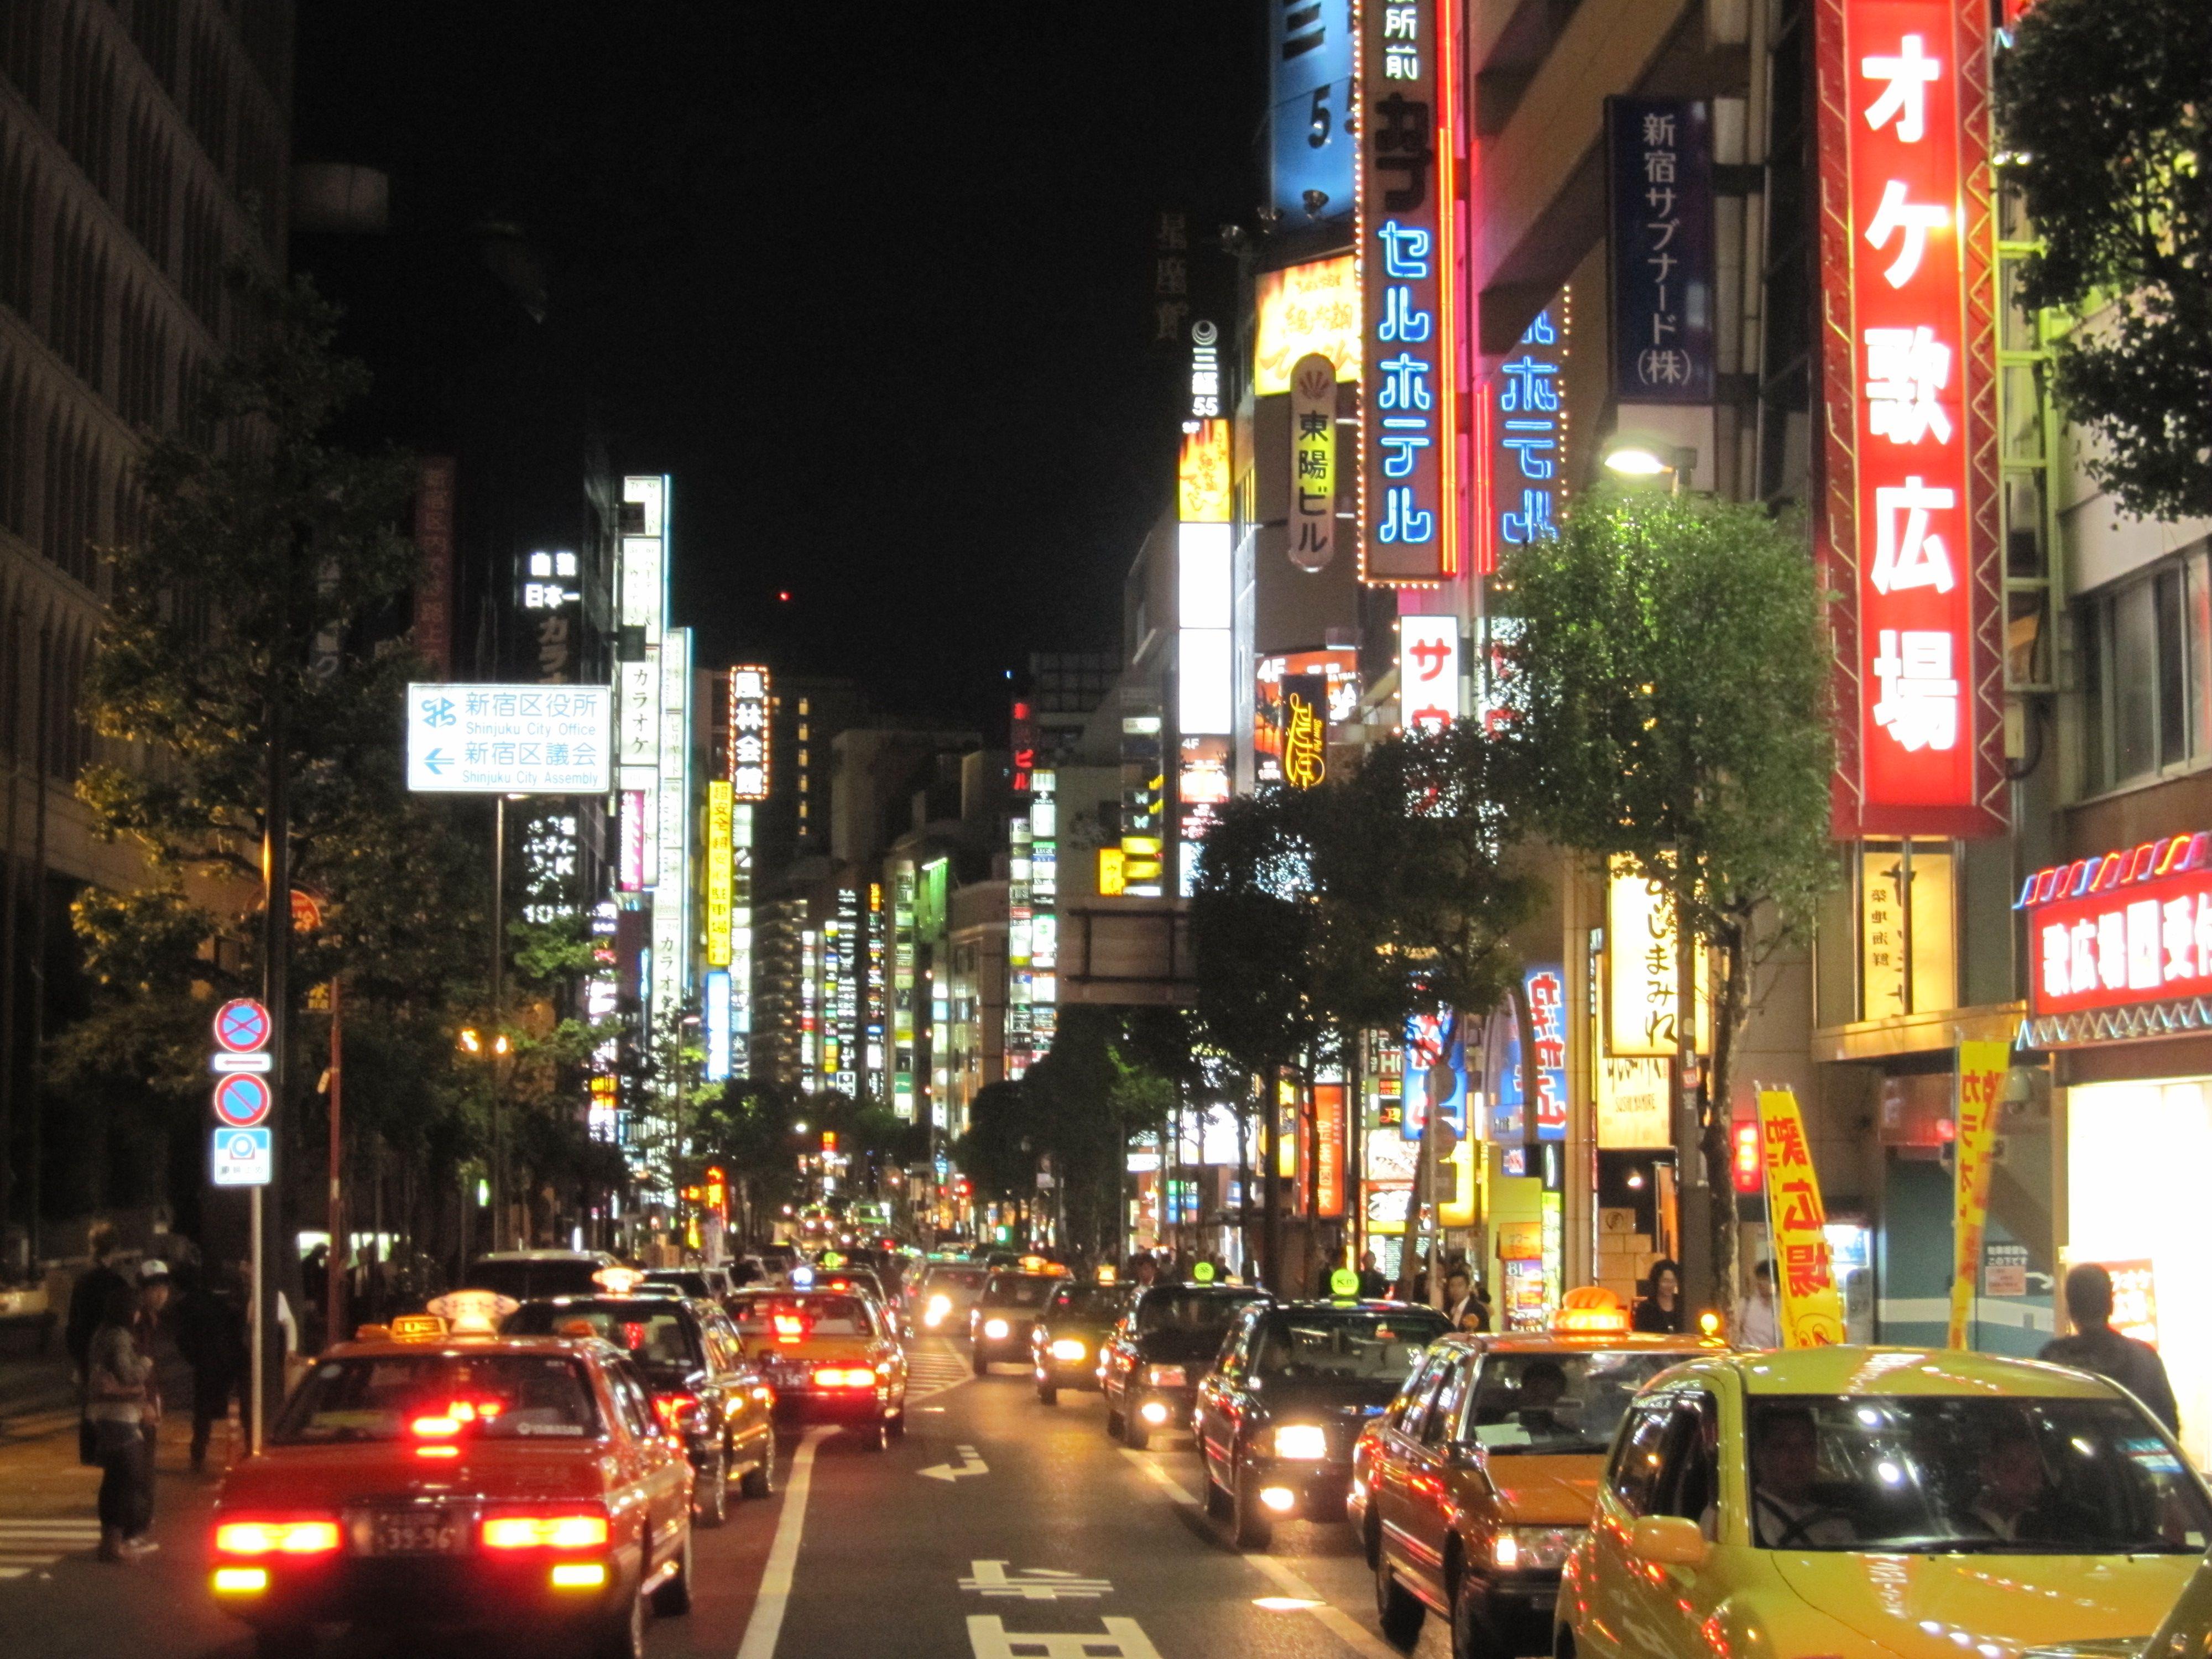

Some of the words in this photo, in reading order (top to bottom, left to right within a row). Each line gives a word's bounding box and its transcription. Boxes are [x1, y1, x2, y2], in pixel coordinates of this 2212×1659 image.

[1384, 0, 1418, 80] 所前
[1861, 34, 1959, 752] オケ歌広場
[1297, 410, 1329, 553] 東陽ビル
[465, 692, 597, 718] 新宿区役所
[466, 722, 520, 738] Shinjuku
[527, 722, 551, 738] City
[559, 722, 596, 735] Office
[632, 668, 649, 754] カラオケ
[462, 770, 511, 785] Shinjuku
[517, 771, 538, 786] City
[544, 770, 598, 787] Assembly
[465, 741, 597, 766] 新宿区議会
